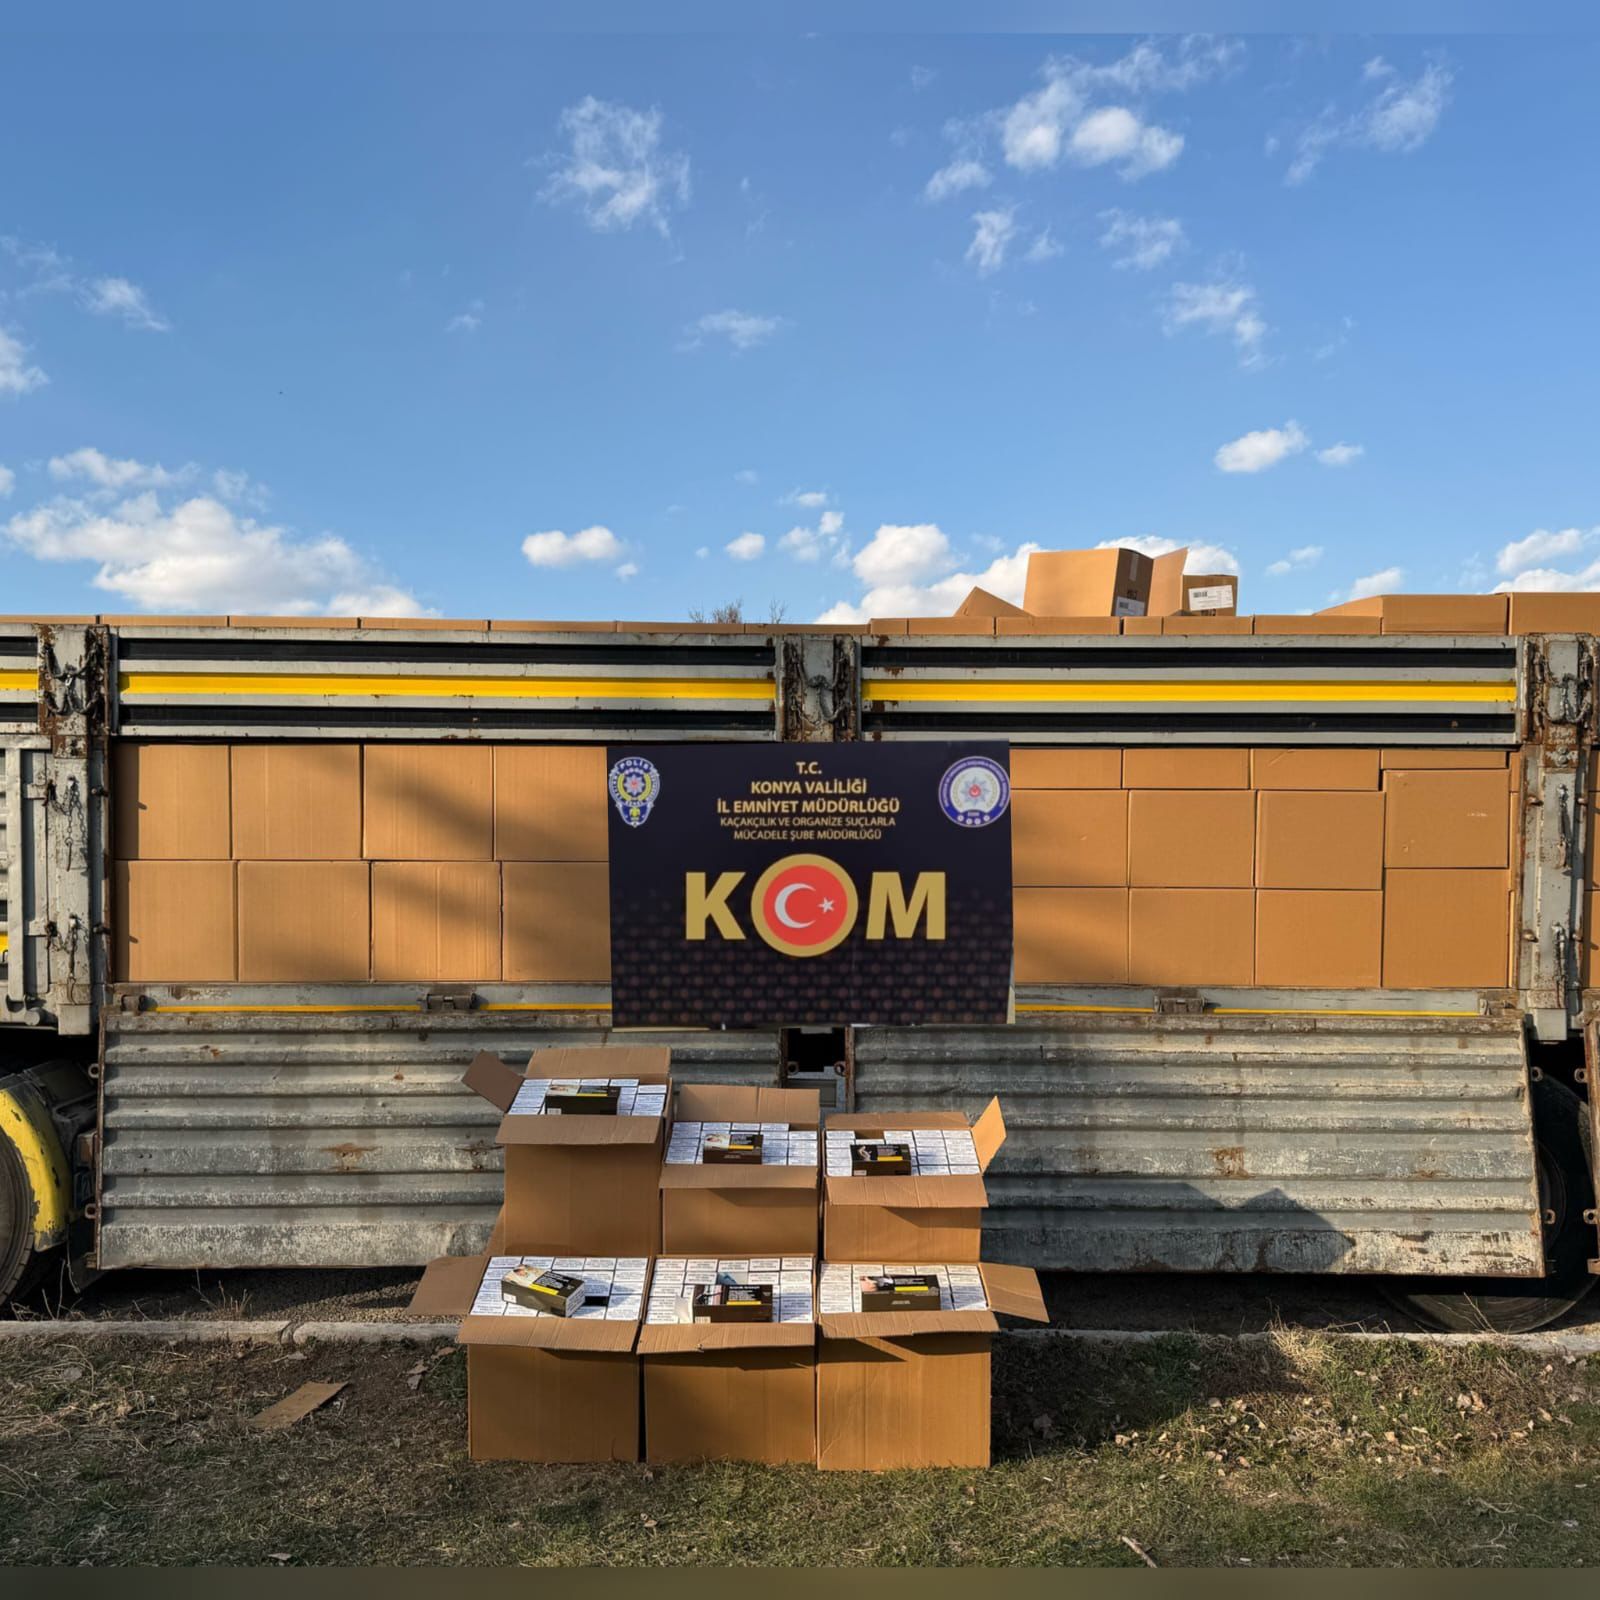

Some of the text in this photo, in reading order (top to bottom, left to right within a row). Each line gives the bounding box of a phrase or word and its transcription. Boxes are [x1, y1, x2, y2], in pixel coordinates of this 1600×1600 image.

[796, 762, 823, 774] T.C.
[751, 778, 867, 794] KONYA VALİLİĞİ
[717, 798, 900, 813] İL EMNİYET MÜDÜRLÜĞÜ
[720, 815, 896, 828] KAÇAKÇILIK VE ORGANİZE SUÇLARLA
[734, 829, 882, 841] MÜCADELE ŞUBE MÜDÜRLÜĞÜ
